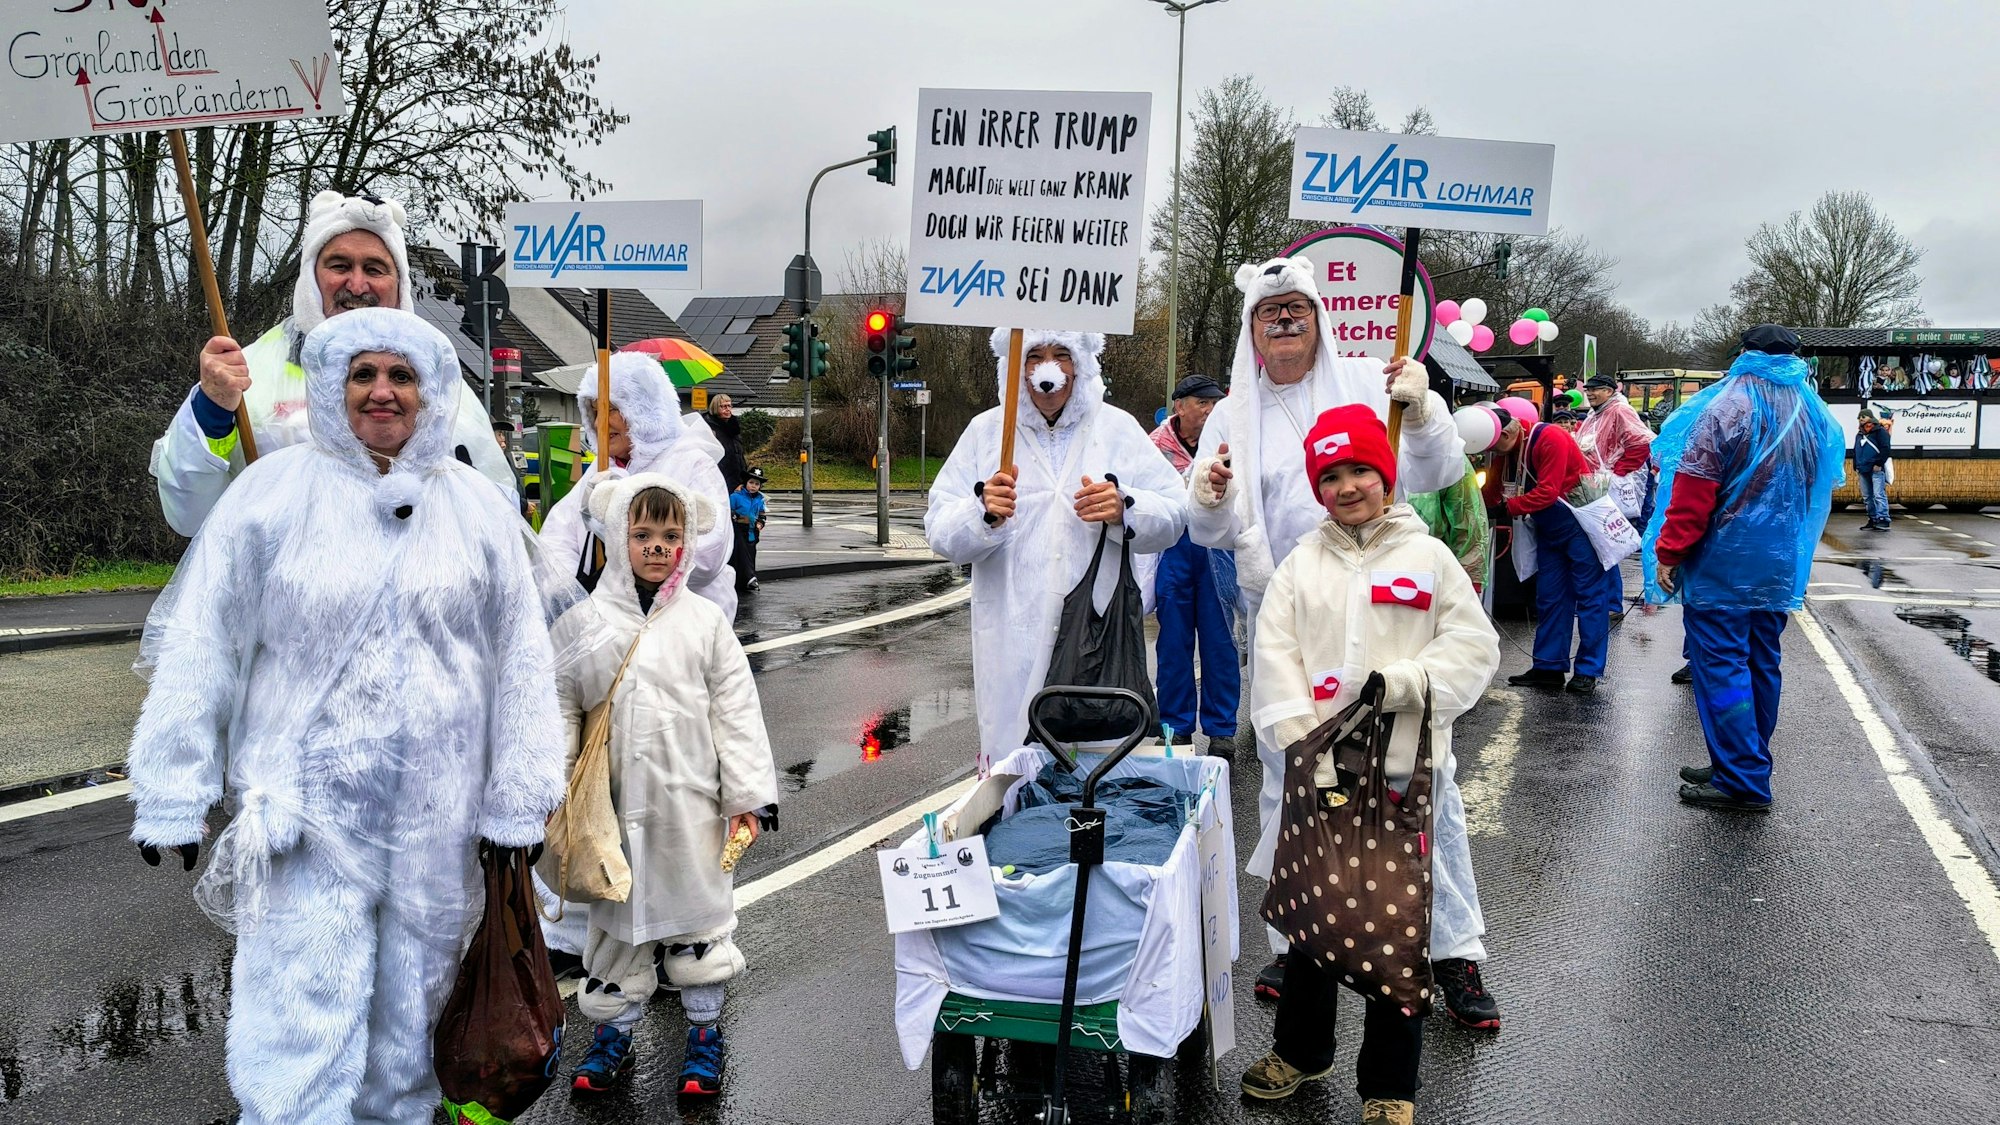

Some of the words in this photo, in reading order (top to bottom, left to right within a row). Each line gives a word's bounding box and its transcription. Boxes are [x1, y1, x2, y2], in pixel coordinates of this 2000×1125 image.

[93, 79, 293, 122] Grönländern
[1054, 111, 1138, 154] TRUMP
[928, 165, 987, 195] MACHT
[1008, 179, 1035, 197] WELT
[1040, 179, 1067, 197] GANZ
[1073, 170, 1133, 200] KRANK
[1302, 143, 1429, 214] ZWAR
[1437, 182, 1534, 206] LOHMAR
[1302, 193, 1333, 202] ZWISCHEN
[1386, 200, 1424, 208] RUHESTAND
[925, 212, 968, 240] DOCH
[513, 212, 606, 278] ZWAR
[613, 244, 688, 262] LOHMAR
[919, 259, 1006, 307] ZWAR
[1059, 268, 1123, 307] DANK
[1328, 261, 1357, 282] Et
[1902, 410, 1972, 419] Dorfgemeinschaft
[913, 868, 958, 880] Zugnummer
[921, 884, 961, 912] 11
